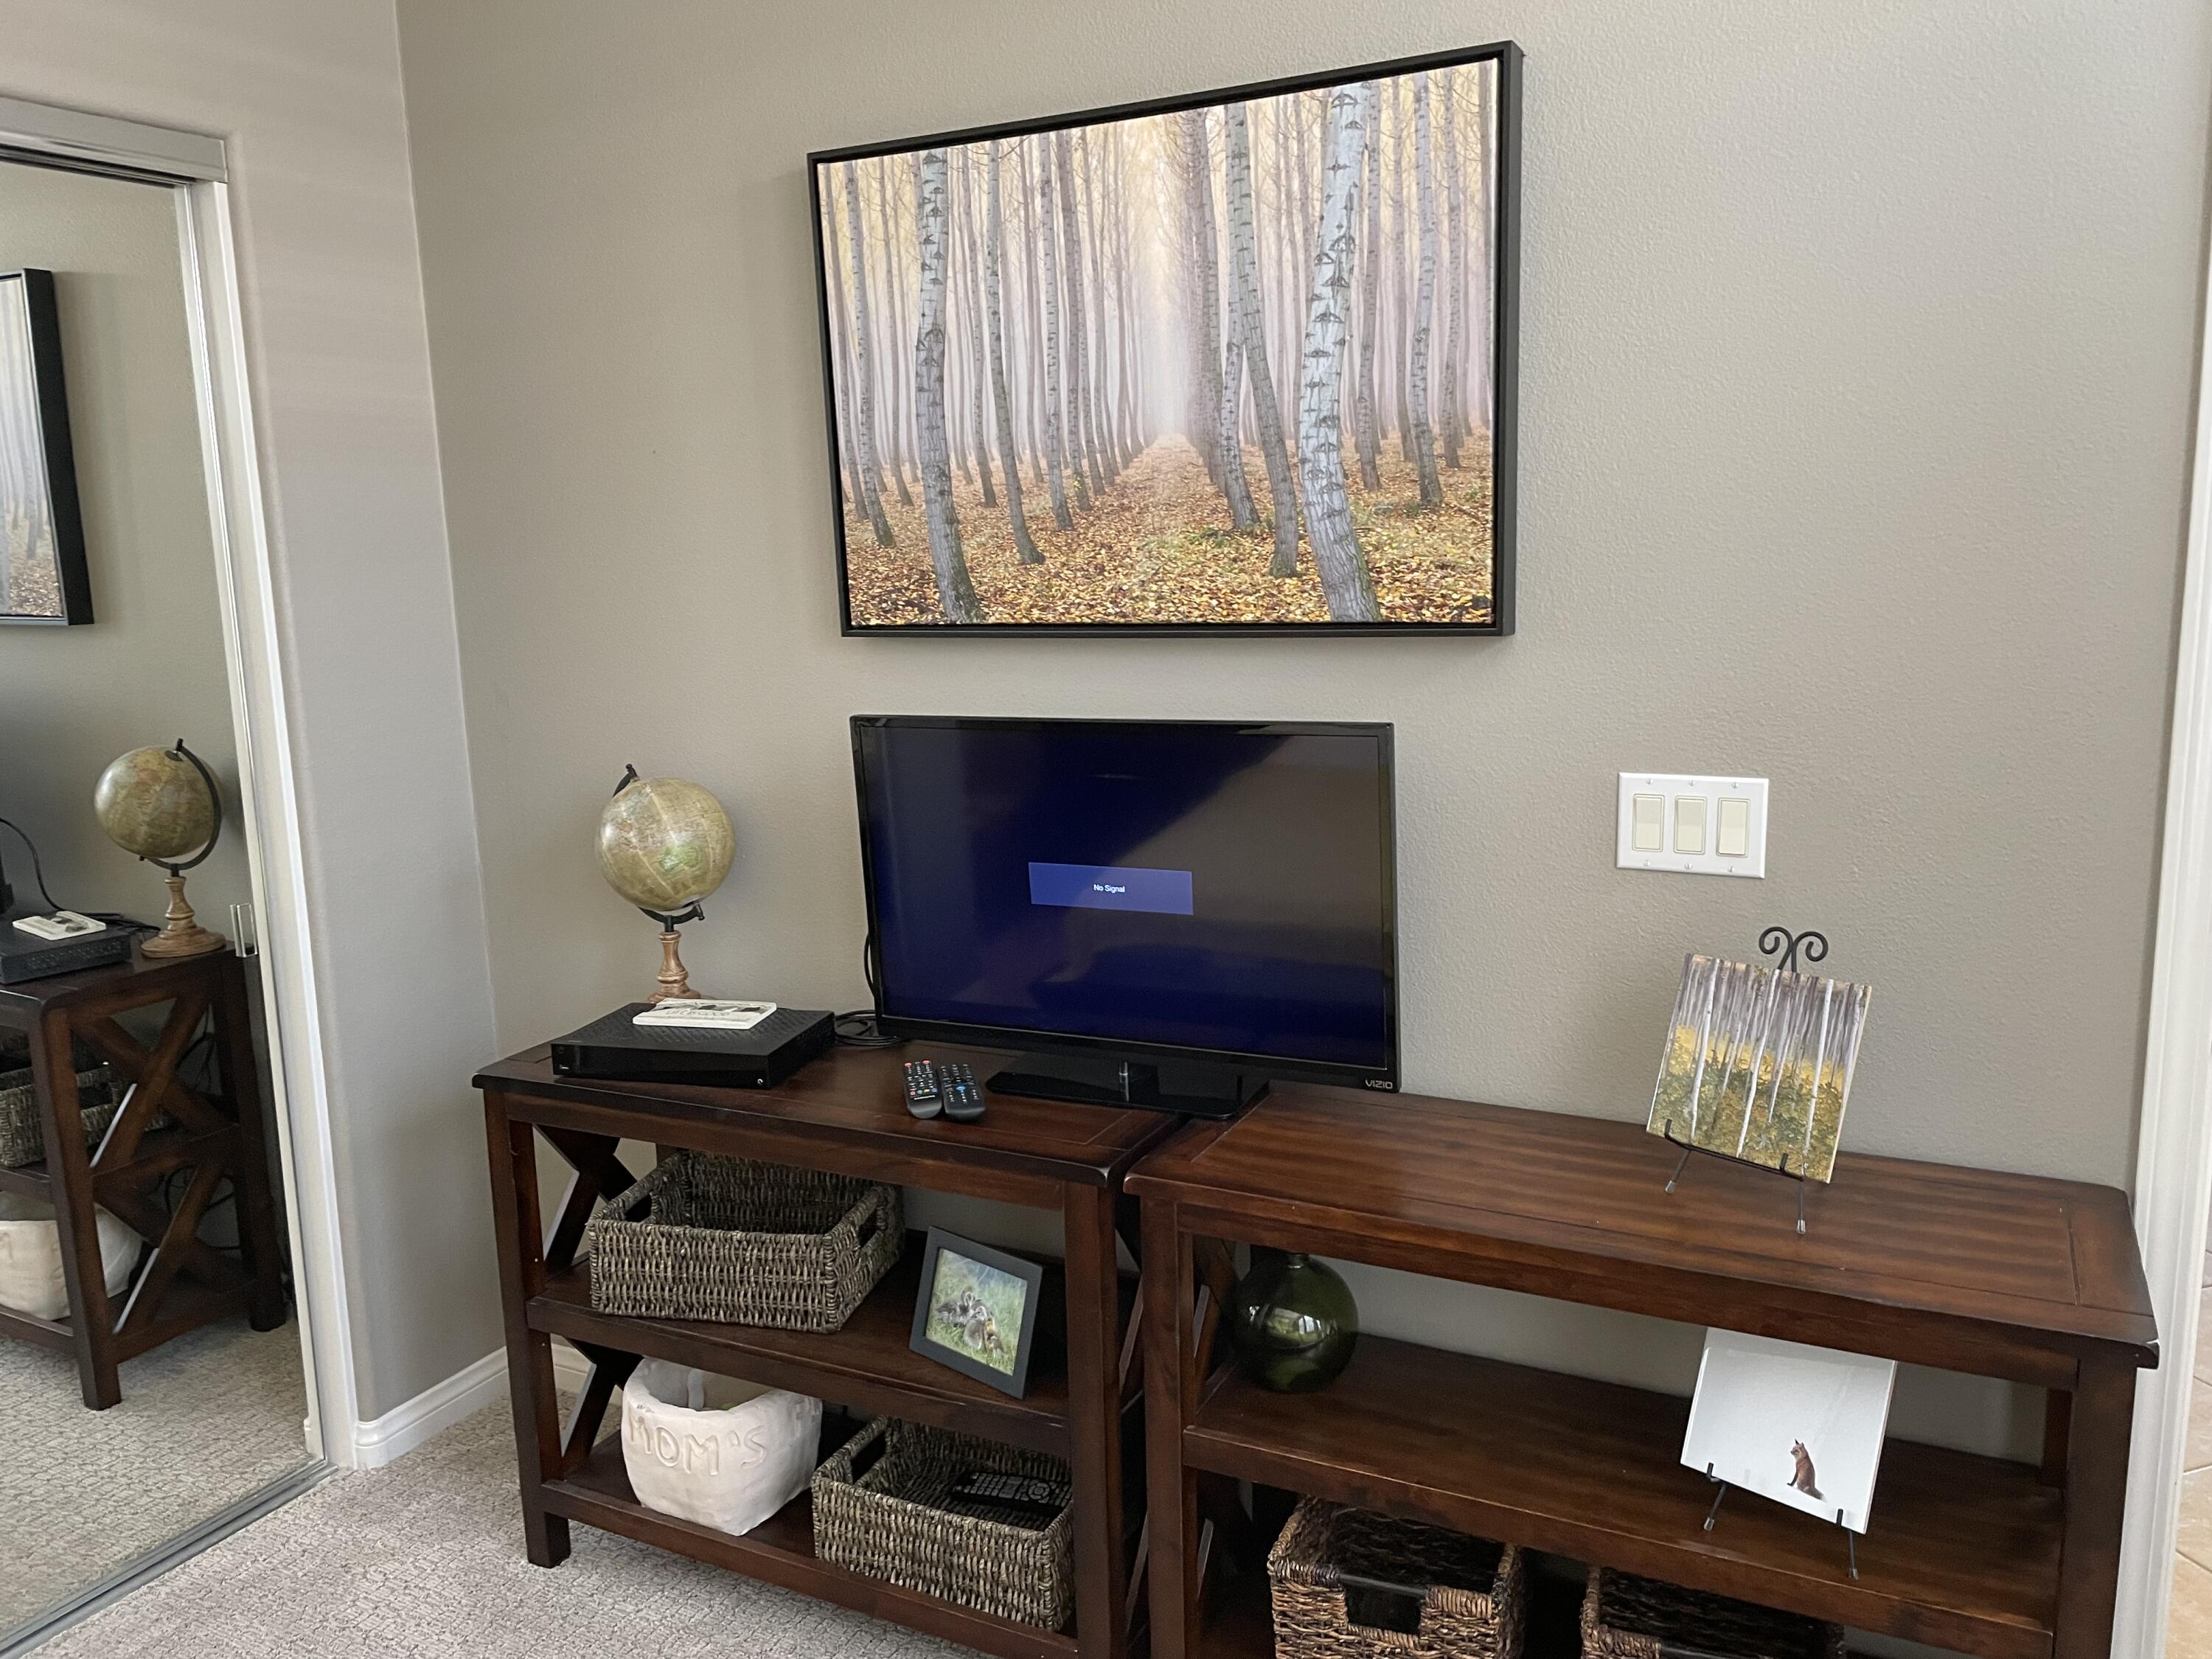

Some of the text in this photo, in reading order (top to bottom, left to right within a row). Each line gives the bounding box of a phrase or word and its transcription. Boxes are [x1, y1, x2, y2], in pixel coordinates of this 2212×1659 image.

[1105, 884, 1125, 894] Signal
[1365, 1079, 1393, 1089] VIZIO
[628, 1413, 767, 1475] MOM'S
